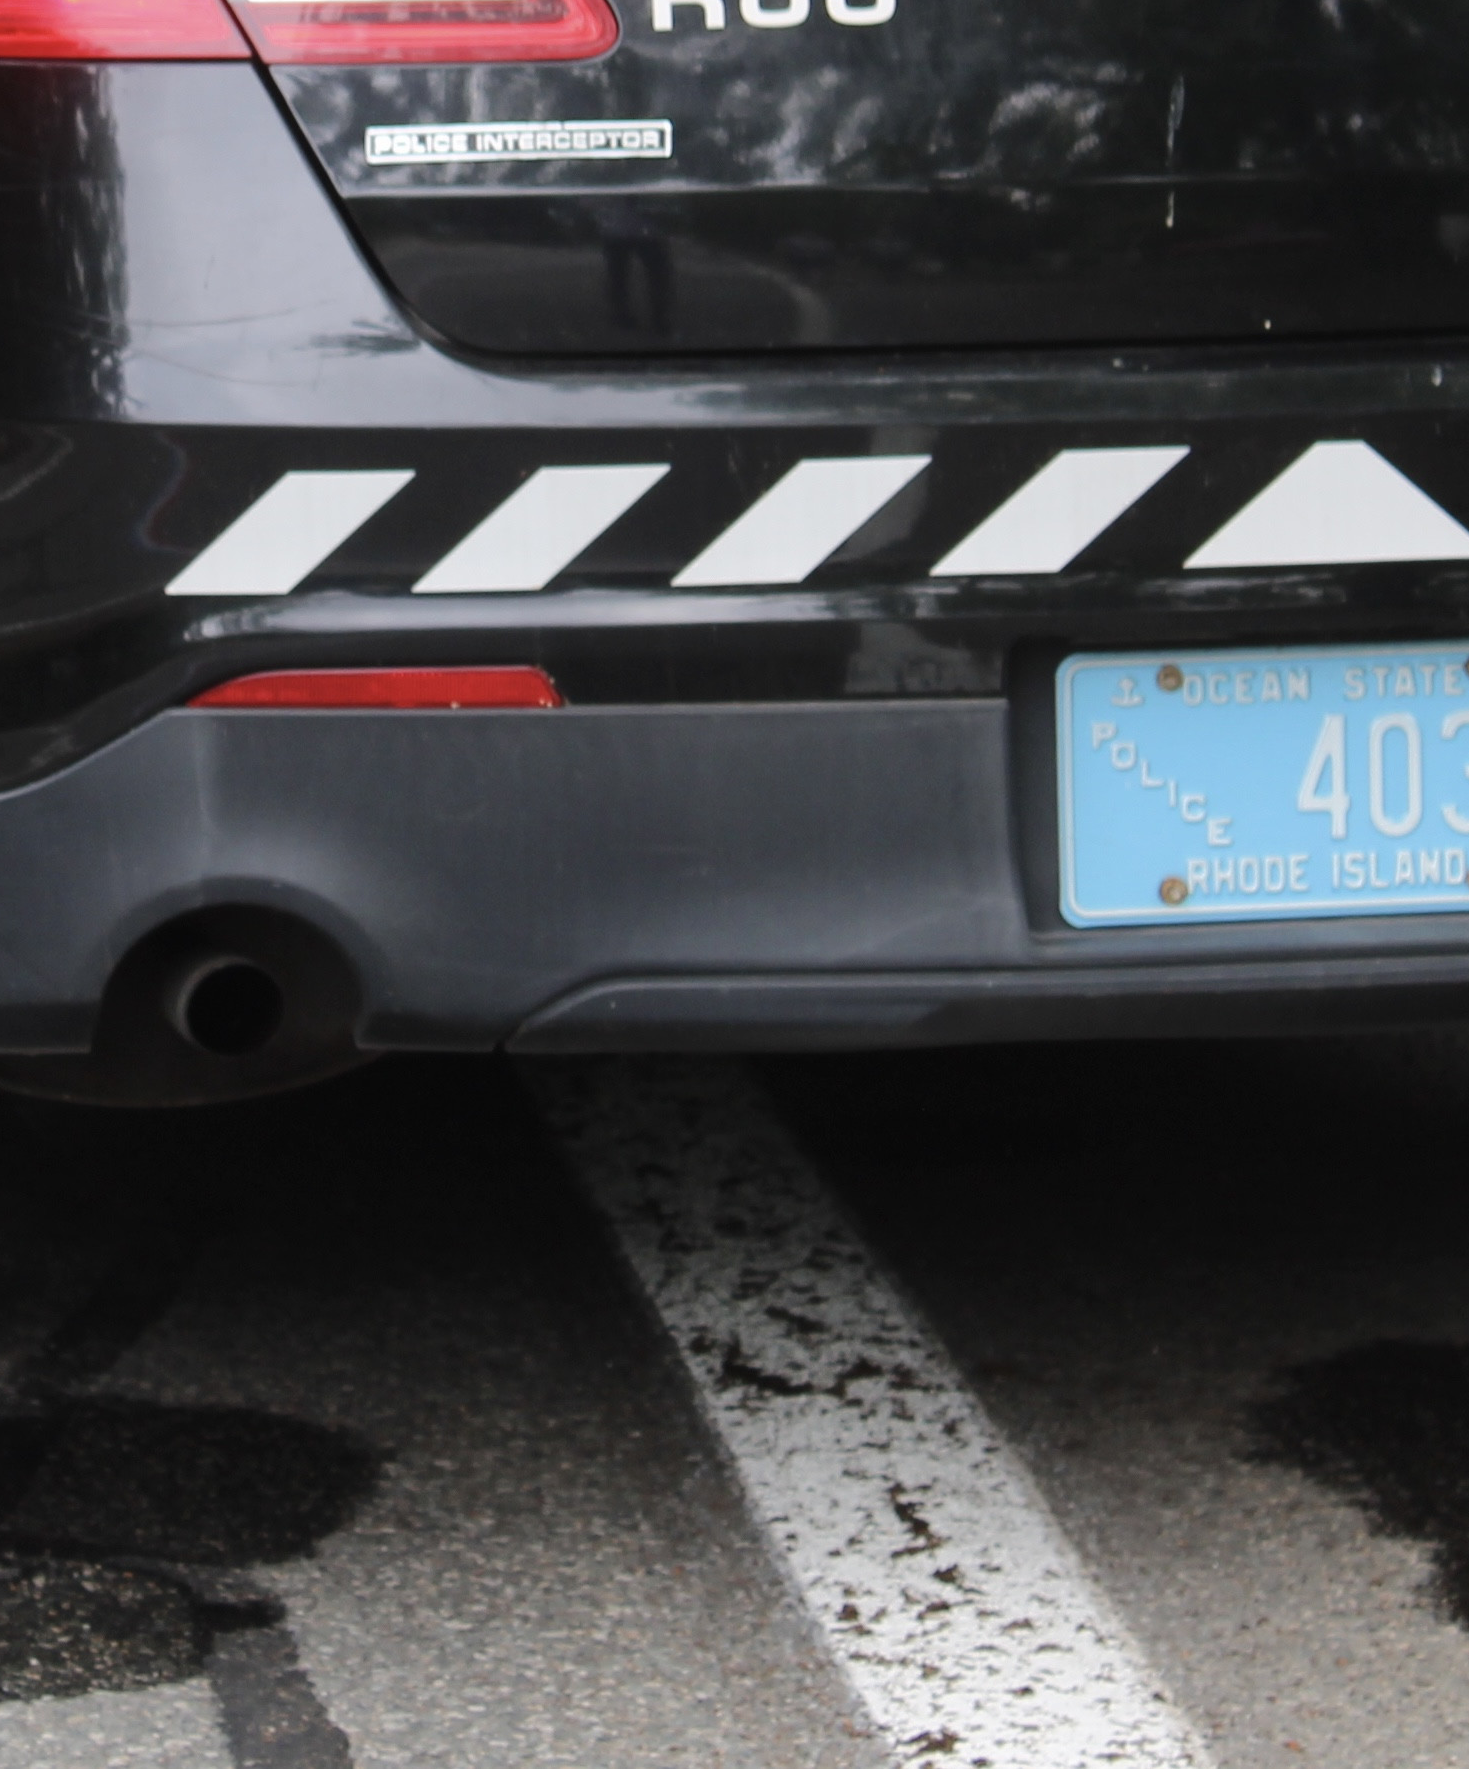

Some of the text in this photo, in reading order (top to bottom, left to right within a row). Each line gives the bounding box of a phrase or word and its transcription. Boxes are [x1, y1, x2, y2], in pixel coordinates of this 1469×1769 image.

[374, 129, 661, 155] POLICE INTERCEPTOR
[1181, 661, 1466, 706] OCEAN STATE
[1091, 720, 1232, 847] POLICE
[1184, 847, 1468, 894] RHODE ISLAND
